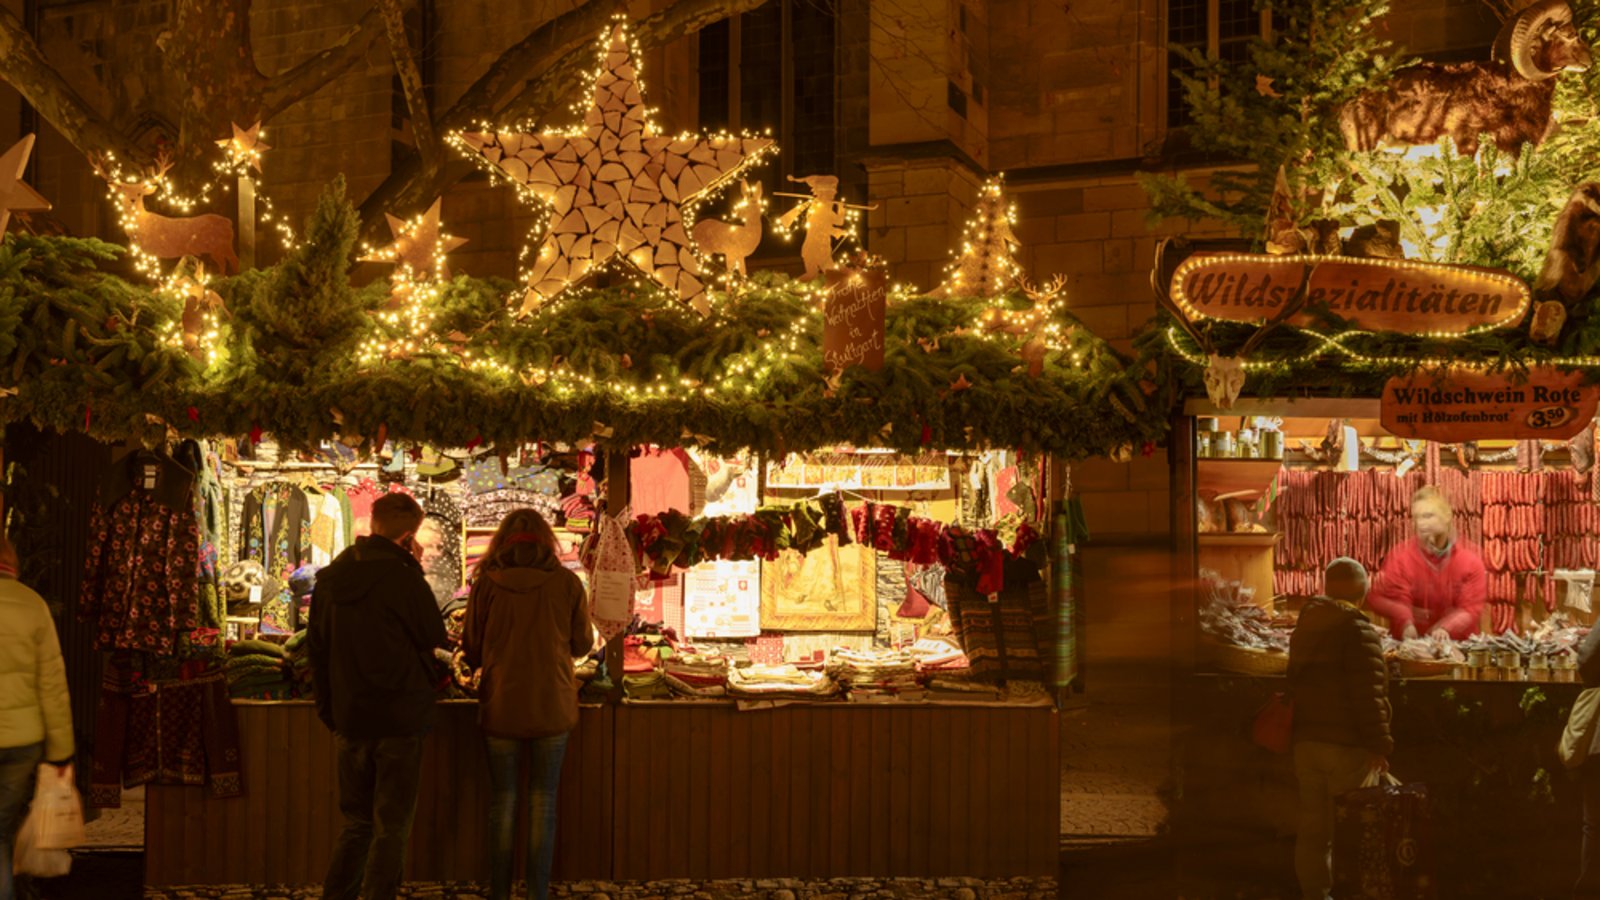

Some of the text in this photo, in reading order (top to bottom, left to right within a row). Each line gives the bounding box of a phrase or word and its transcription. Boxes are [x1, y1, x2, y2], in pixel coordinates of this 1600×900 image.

[849, 327, 861, 338] in
[825, 329, 881, 368] Stuttgart
[1393, 386, 1581, 405] Wildschwein Rote
[1396, 411, 1418, 423] mit
